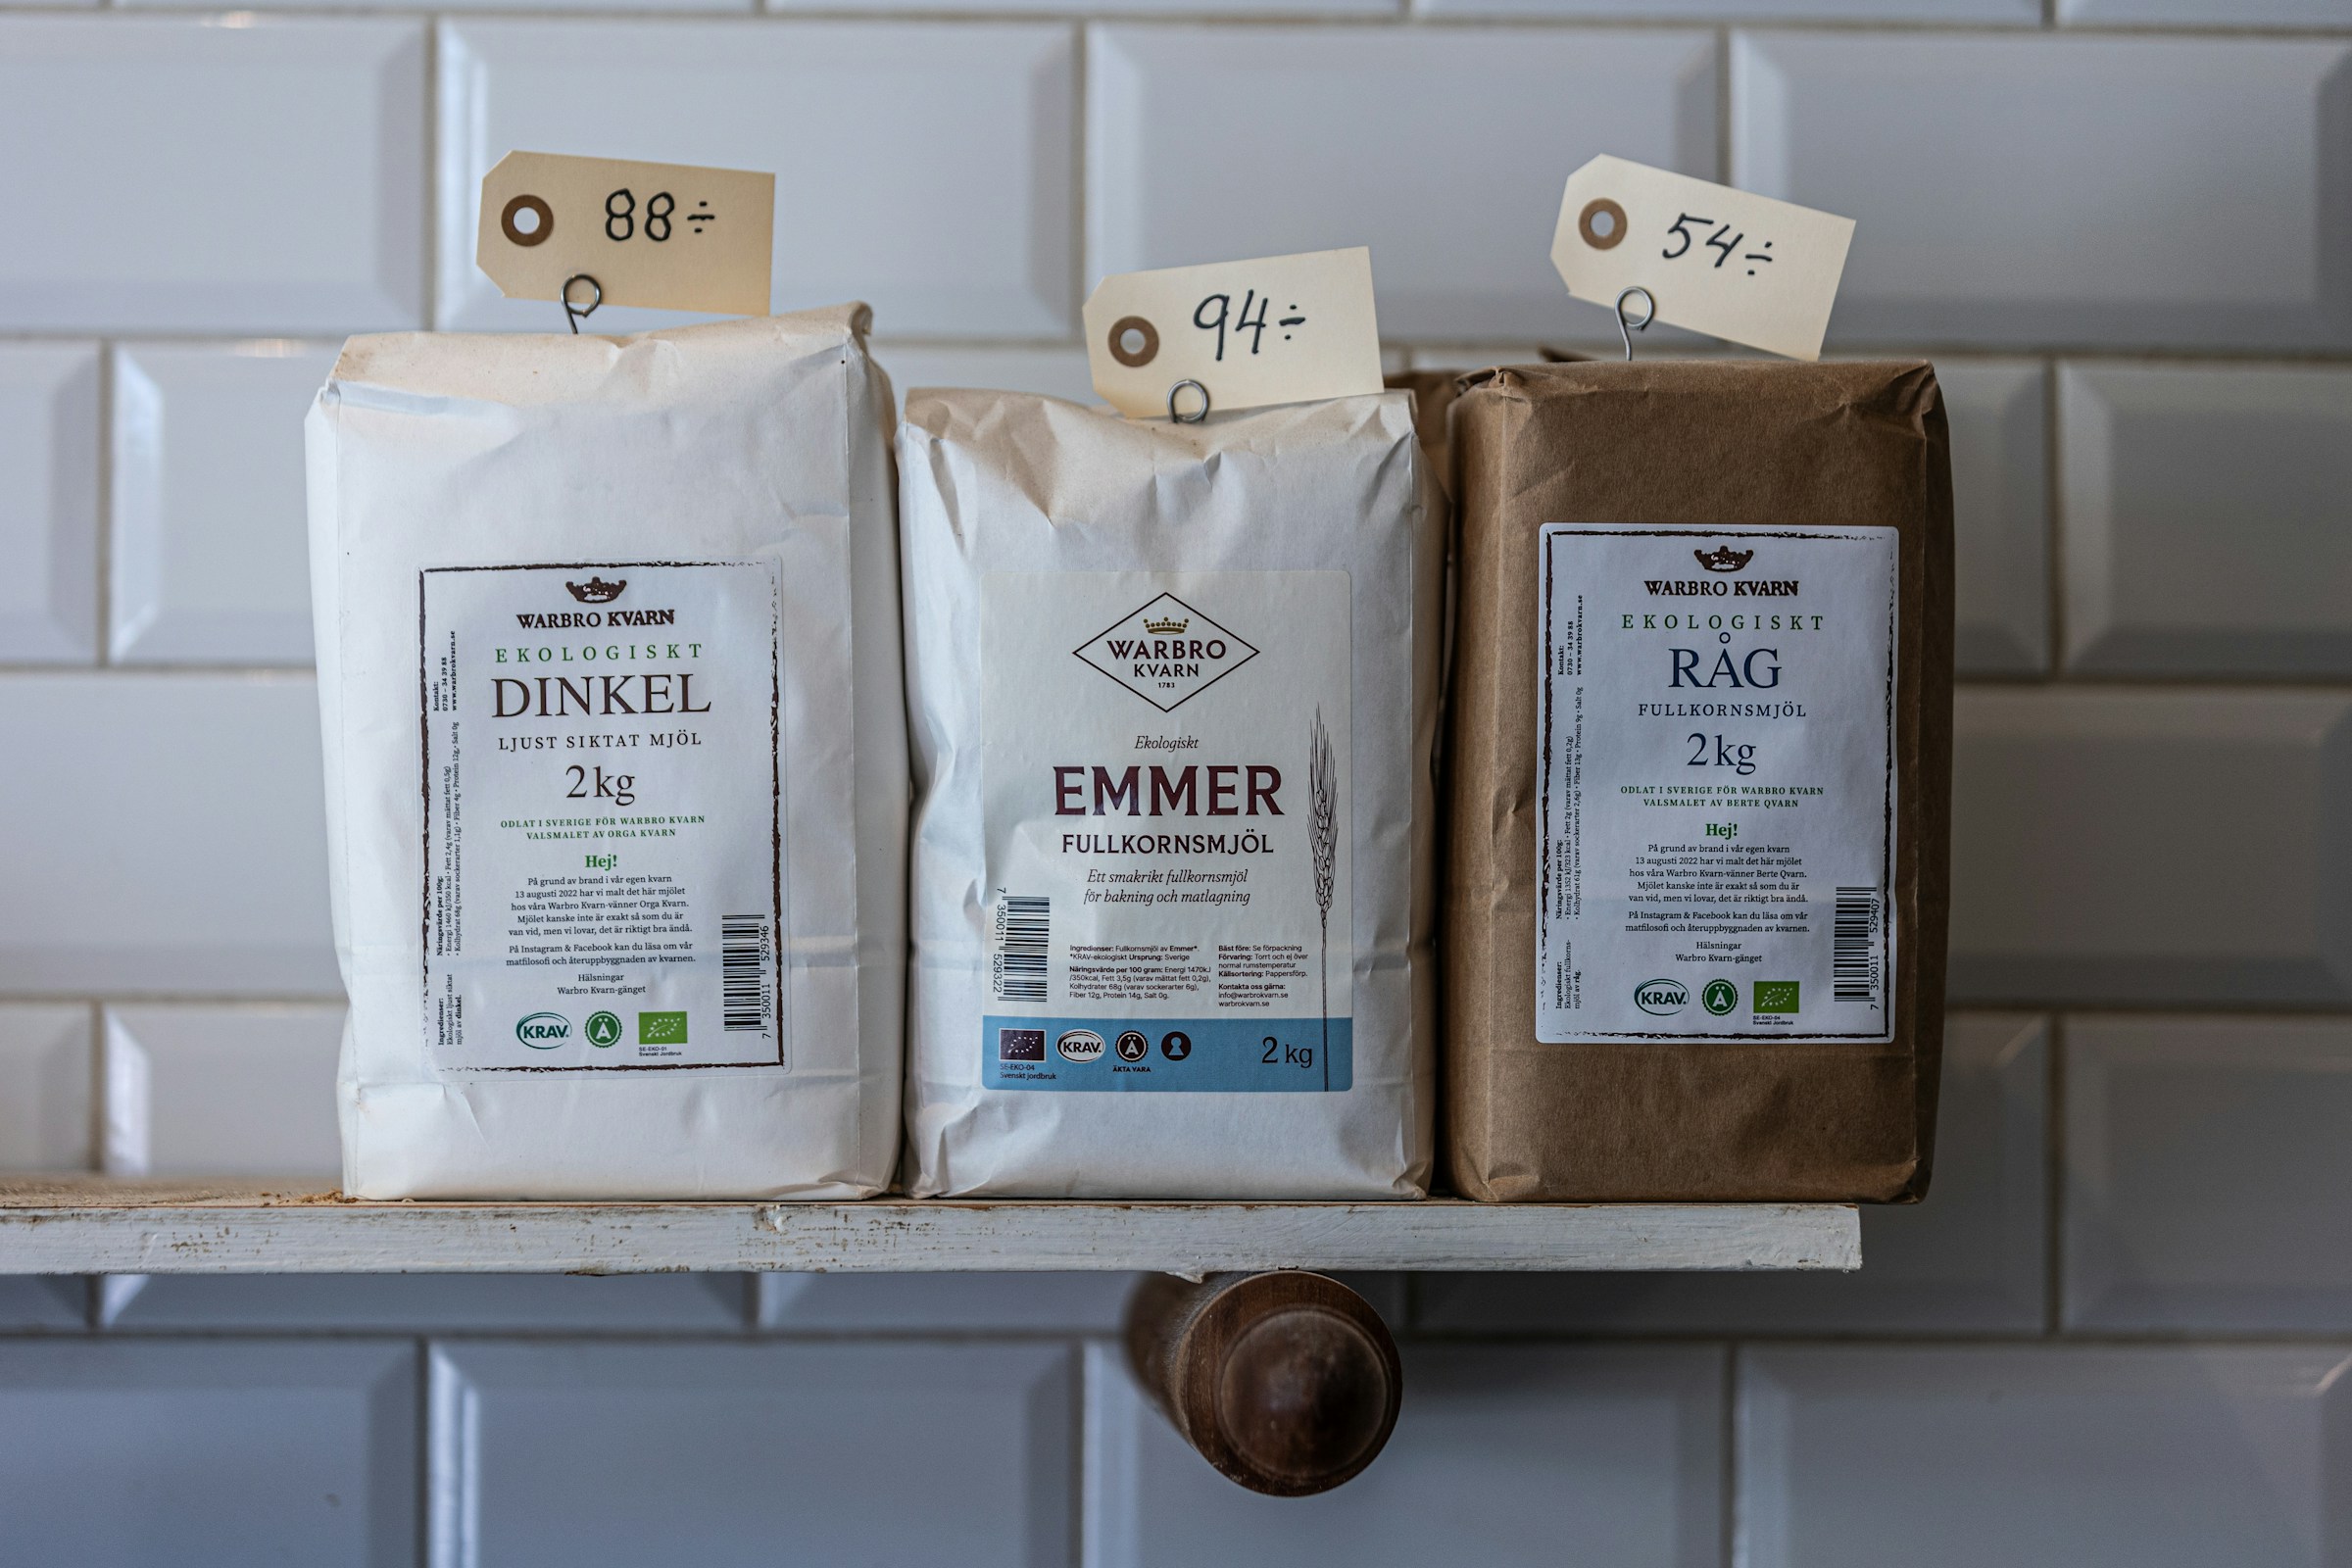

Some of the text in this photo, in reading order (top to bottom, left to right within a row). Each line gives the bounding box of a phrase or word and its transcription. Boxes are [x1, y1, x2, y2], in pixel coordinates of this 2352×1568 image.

[1643, 580, 1798, 596] WARBRO KVARN
[515, 609, 674, 628] WARBRO KVARN
[1621, 613, 1823, 630] EKOLOGISKT
[495, 643, 701, 662] EKOLOGISKT
[1106, 639, 1226, 660] WARBRO
[1668, 631, 1782, 689] RÅG
[1134, 662, 1199, 677] KVARN
[490, 673, 711, 717] DINKEL
[1638, 701, 1806, 719] FULLKORNSMJÖL
[498, 729, 701, 753] LJUST SIKTAT MJÖL
[1134, 734, 1199, 753] Ekologiskt
[1053, 764, 1284, 816] EMMER
[1620, 785, 1655, 794] ODLAT
[1716, 785, 1737, 794] FÖR
[1740, 786, 1785, 795] WARBRO
[1642, 798, 1706, 807] VALSMALET
[1763, 799, 1798, 808] QVARN
[500, 819, 535, 828] ODLAT
[595, 816, 615, 825] FÖR
[619, 815, 664, 824] WARBRO
[526, 830, 589, 839] VALSMALET
[607, 829, 636, 838] ORGA
[640, 828, 675, 837] KVARN
[1705, 822, 1738, 840] Hej!
[1062, 828, 1273, 855] FULLKORNSMJÖL
[585, 854, 616, 871] Hej!
[539, 876, 564, 887] grund
[578, 875, 604, 884] brand
[610, 874, 623, 883] vår
[625, 876, 646, 885] egen
[1087, 868, 1248, 886] Ett smakrikt fullkornsmjöl
[1083, 888, 1250, 906] för bakning och matlagning
[995, 904, 1006, 942] 350011
[1640, 910, 1682, 921] Instagram
[1692, 910, 1731, 919] Facebook
[1732, 910, 1747, 919] kan
[1749, 910, 1760, 919] du
[1870, 898, 1880, 934] 529407
[760, 925, 770, 961] 529346
[577, 972, 624, 983] Hälsningar
[993, 953, 1004, 993] 529322
[1870, 955, 1879, 991] 350011
[557, 985, 646, 995] Warbro Kvarn-gänget
[761, 983, 771, 1019] 350011
